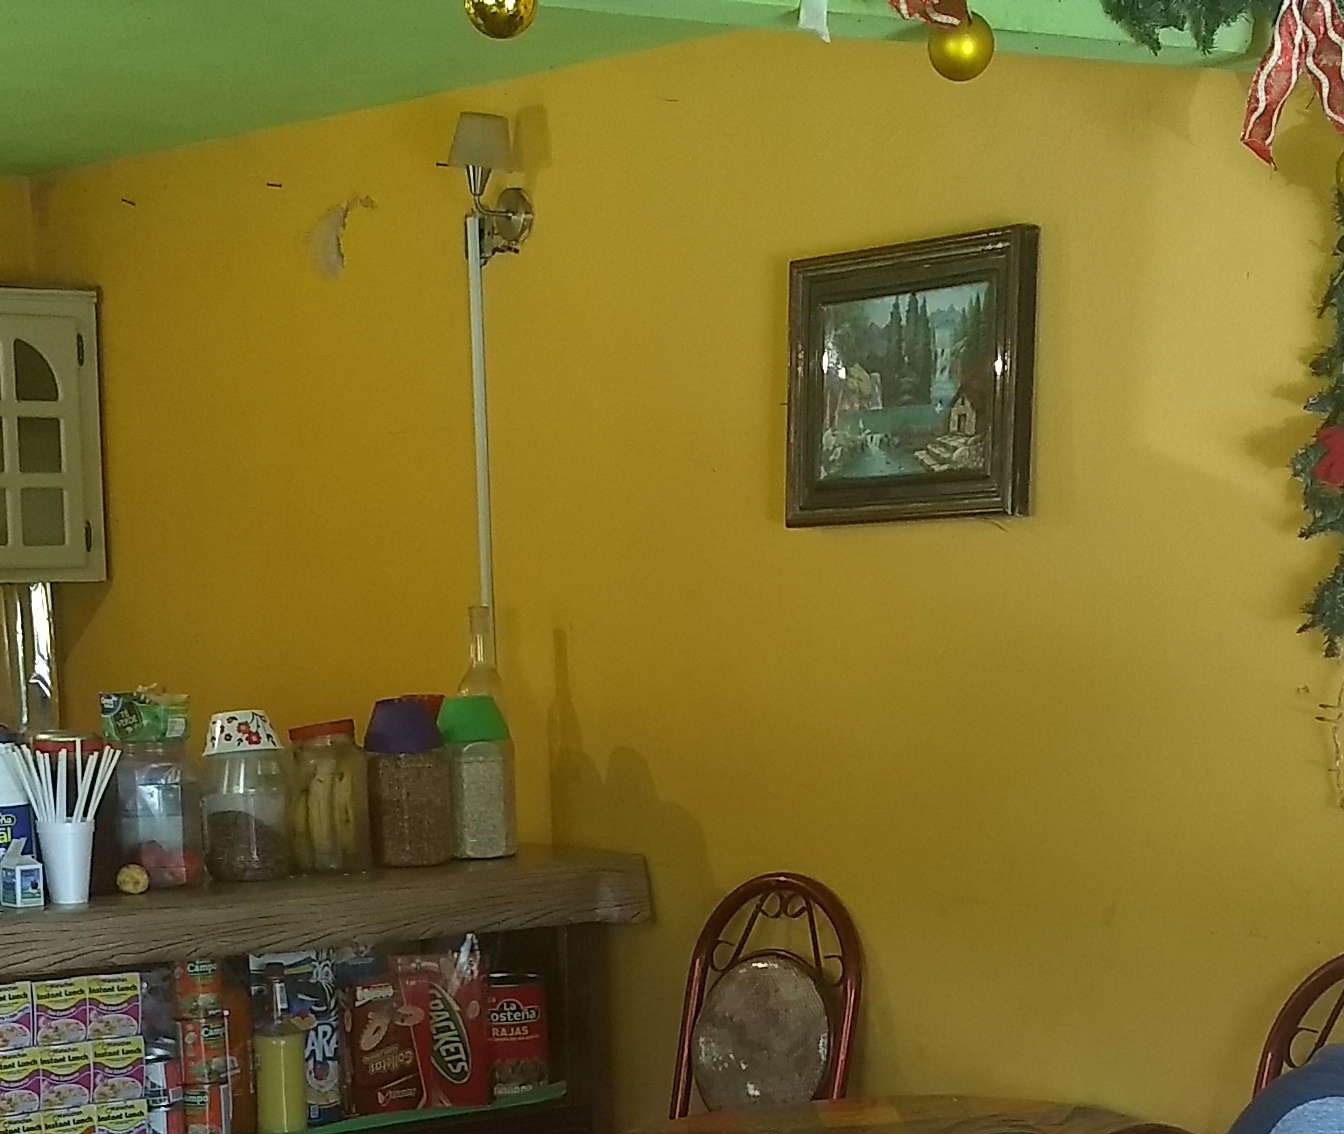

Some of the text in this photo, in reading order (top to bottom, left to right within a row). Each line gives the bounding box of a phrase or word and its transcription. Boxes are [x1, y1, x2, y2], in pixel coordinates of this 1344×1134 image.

[64, 988, 85, 996] Lunch
[117, 984, 138, 992] Lunch
[8, 991, 28, 1000] Lunch
[503, 1002, 516, 1011] La
[490, 1008, 536, 1022] osteña
[491, 1025, 529, 1037] RAJAS
[121, 1047, 142, 1055] Lunch
[67, 1053, 89, 1062] Lunch
[17, 1059, 38, 1067] Lunch
[125, 1110, 145, 1118] Lunch
[72, 1115, 93, 1125] Lunch
[22, 1124, 41, 1132] Lunch
